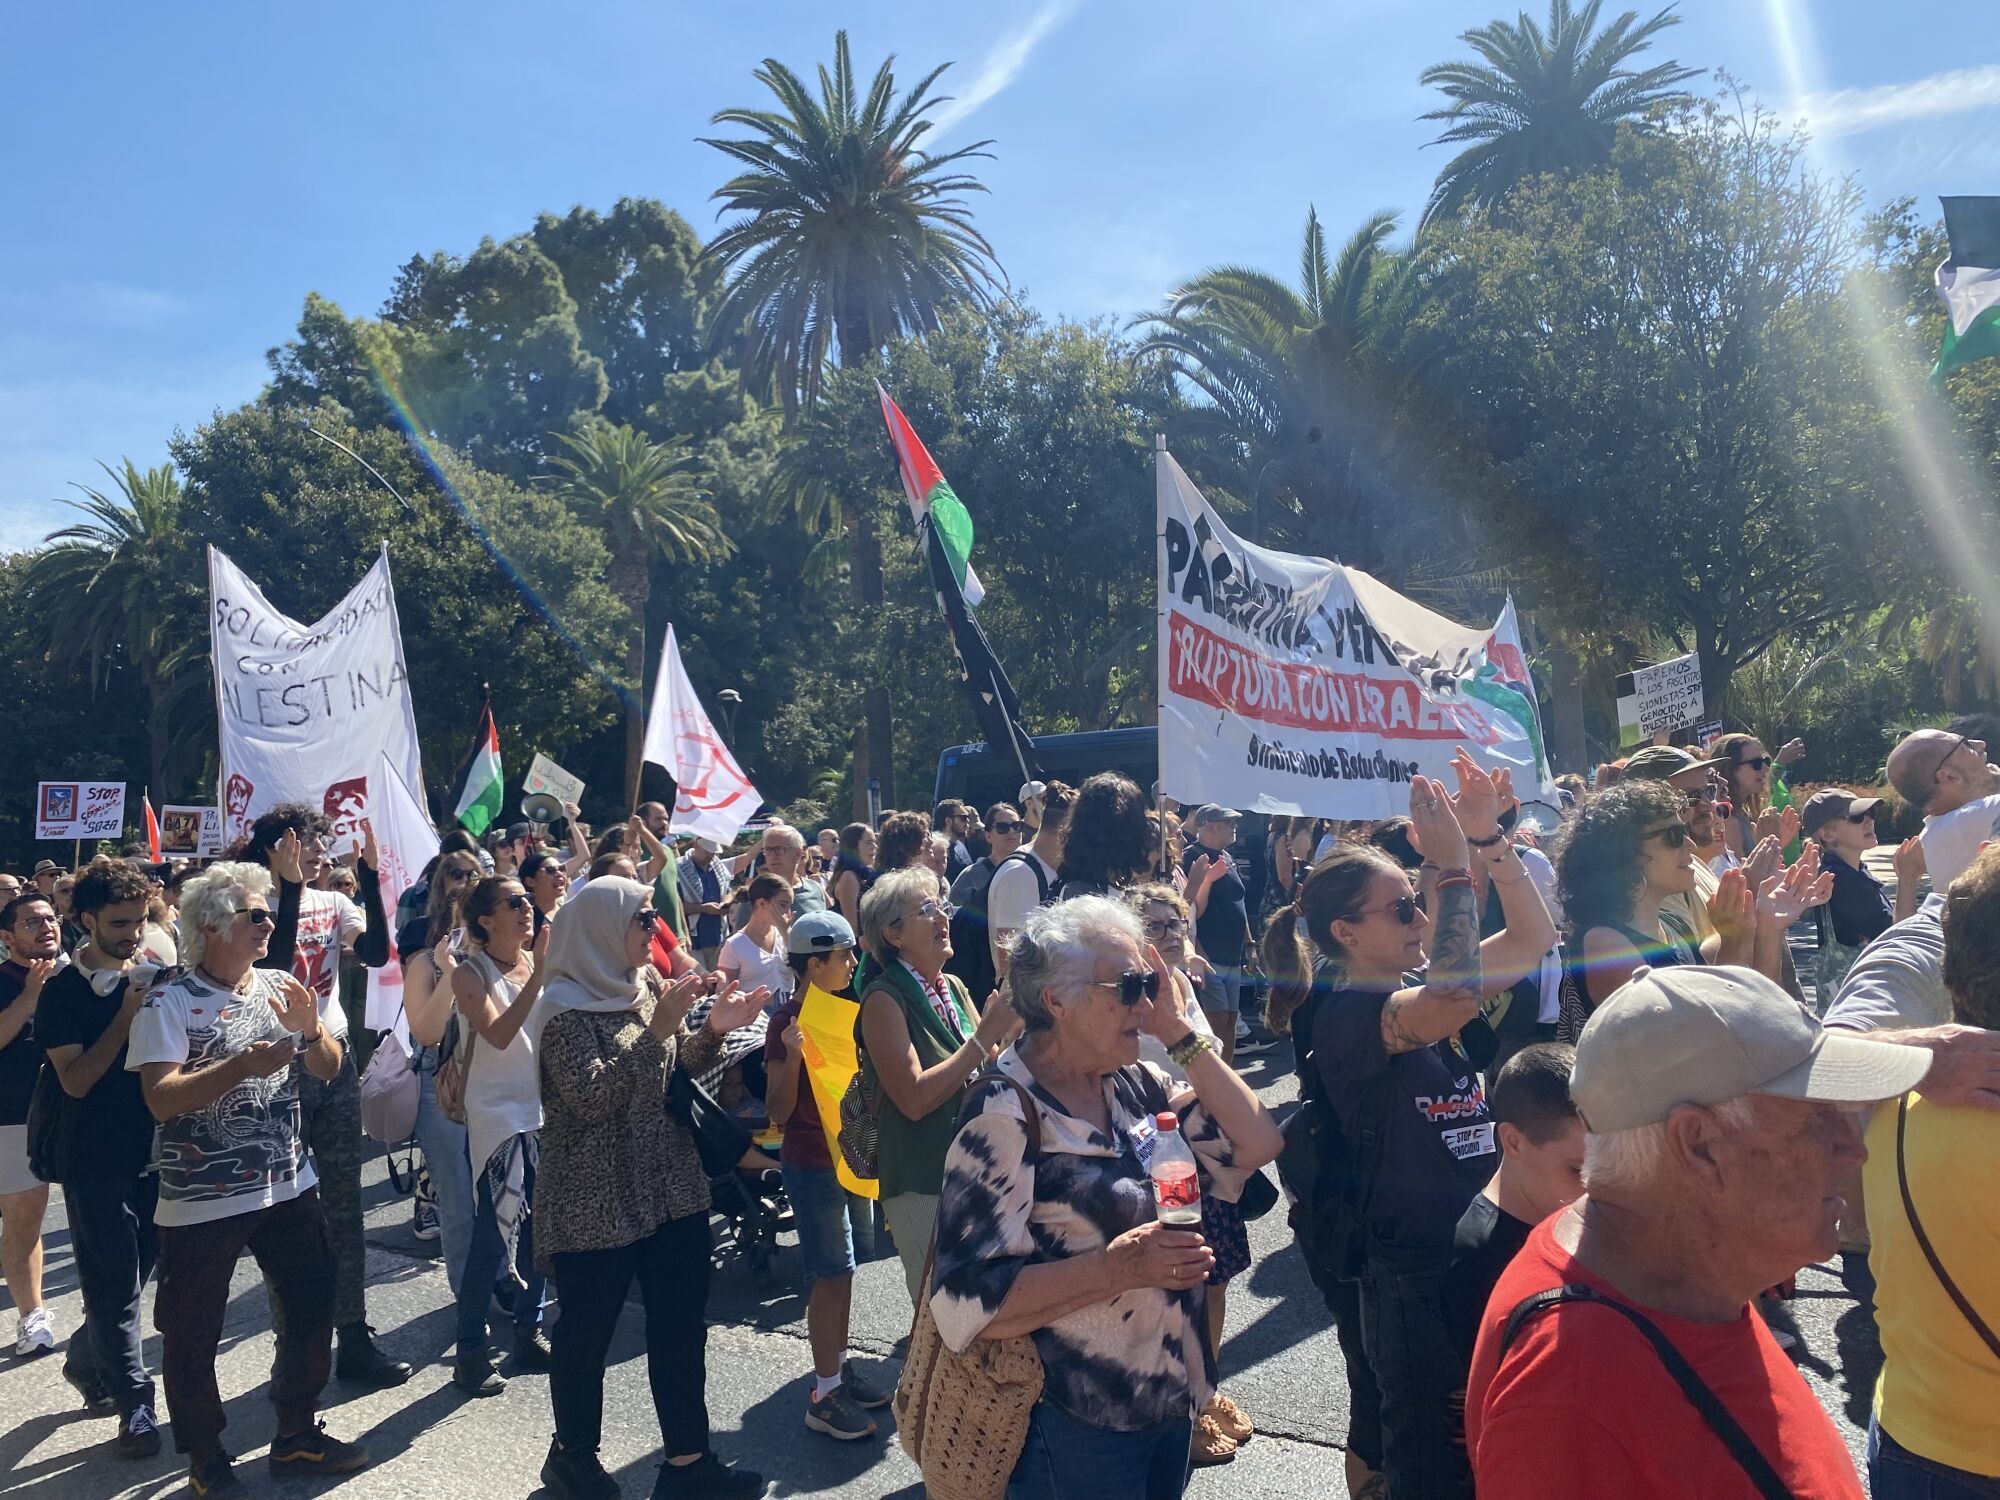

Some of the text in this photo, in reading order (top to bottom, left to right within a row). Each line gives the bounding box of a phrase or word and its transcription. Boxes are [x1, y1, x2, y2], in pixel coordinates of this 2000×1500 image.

[237, 655, 299, 676] CON
[1640, 660, 1691, 684] PAREMOS
[1299, 671, 1351, 724] CON
[1637, 688, 1645, 698] A
[1648, 681, 1664, 694] LOS
[1639, 688, 1686, 712] SIONISTAS
[1641, 697, 1698, 722] GENOCIDIO A
[1642, 711, 1686, 734] PALESTINA
[86, 787, 121, 800] STOP
[1456, 1130, 1472, 1143] STOP
